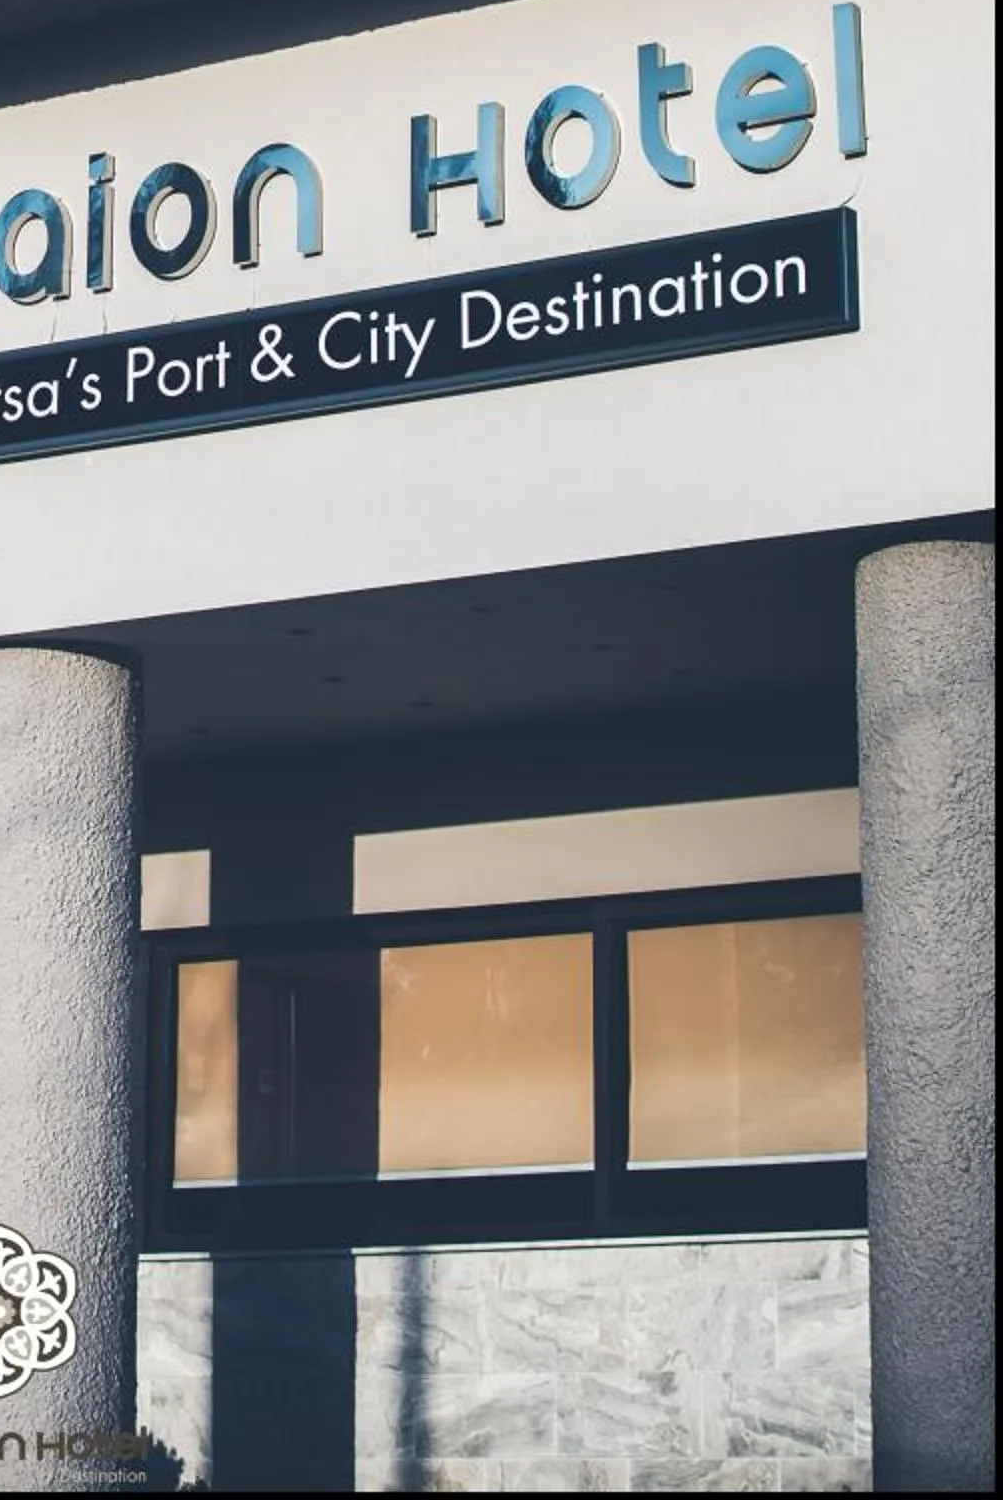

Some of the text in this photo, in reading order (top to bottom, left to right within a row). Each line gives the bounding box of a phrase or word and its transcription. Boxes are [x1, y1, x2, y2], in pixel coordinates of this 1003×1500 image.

[409, 2, 869, 237] Hotel
[125, 341, 230, 404] Port
[250, 325, 296, 381] &
[318, 311, 437, 379] City
[460, 252, 808, 350] Destination
